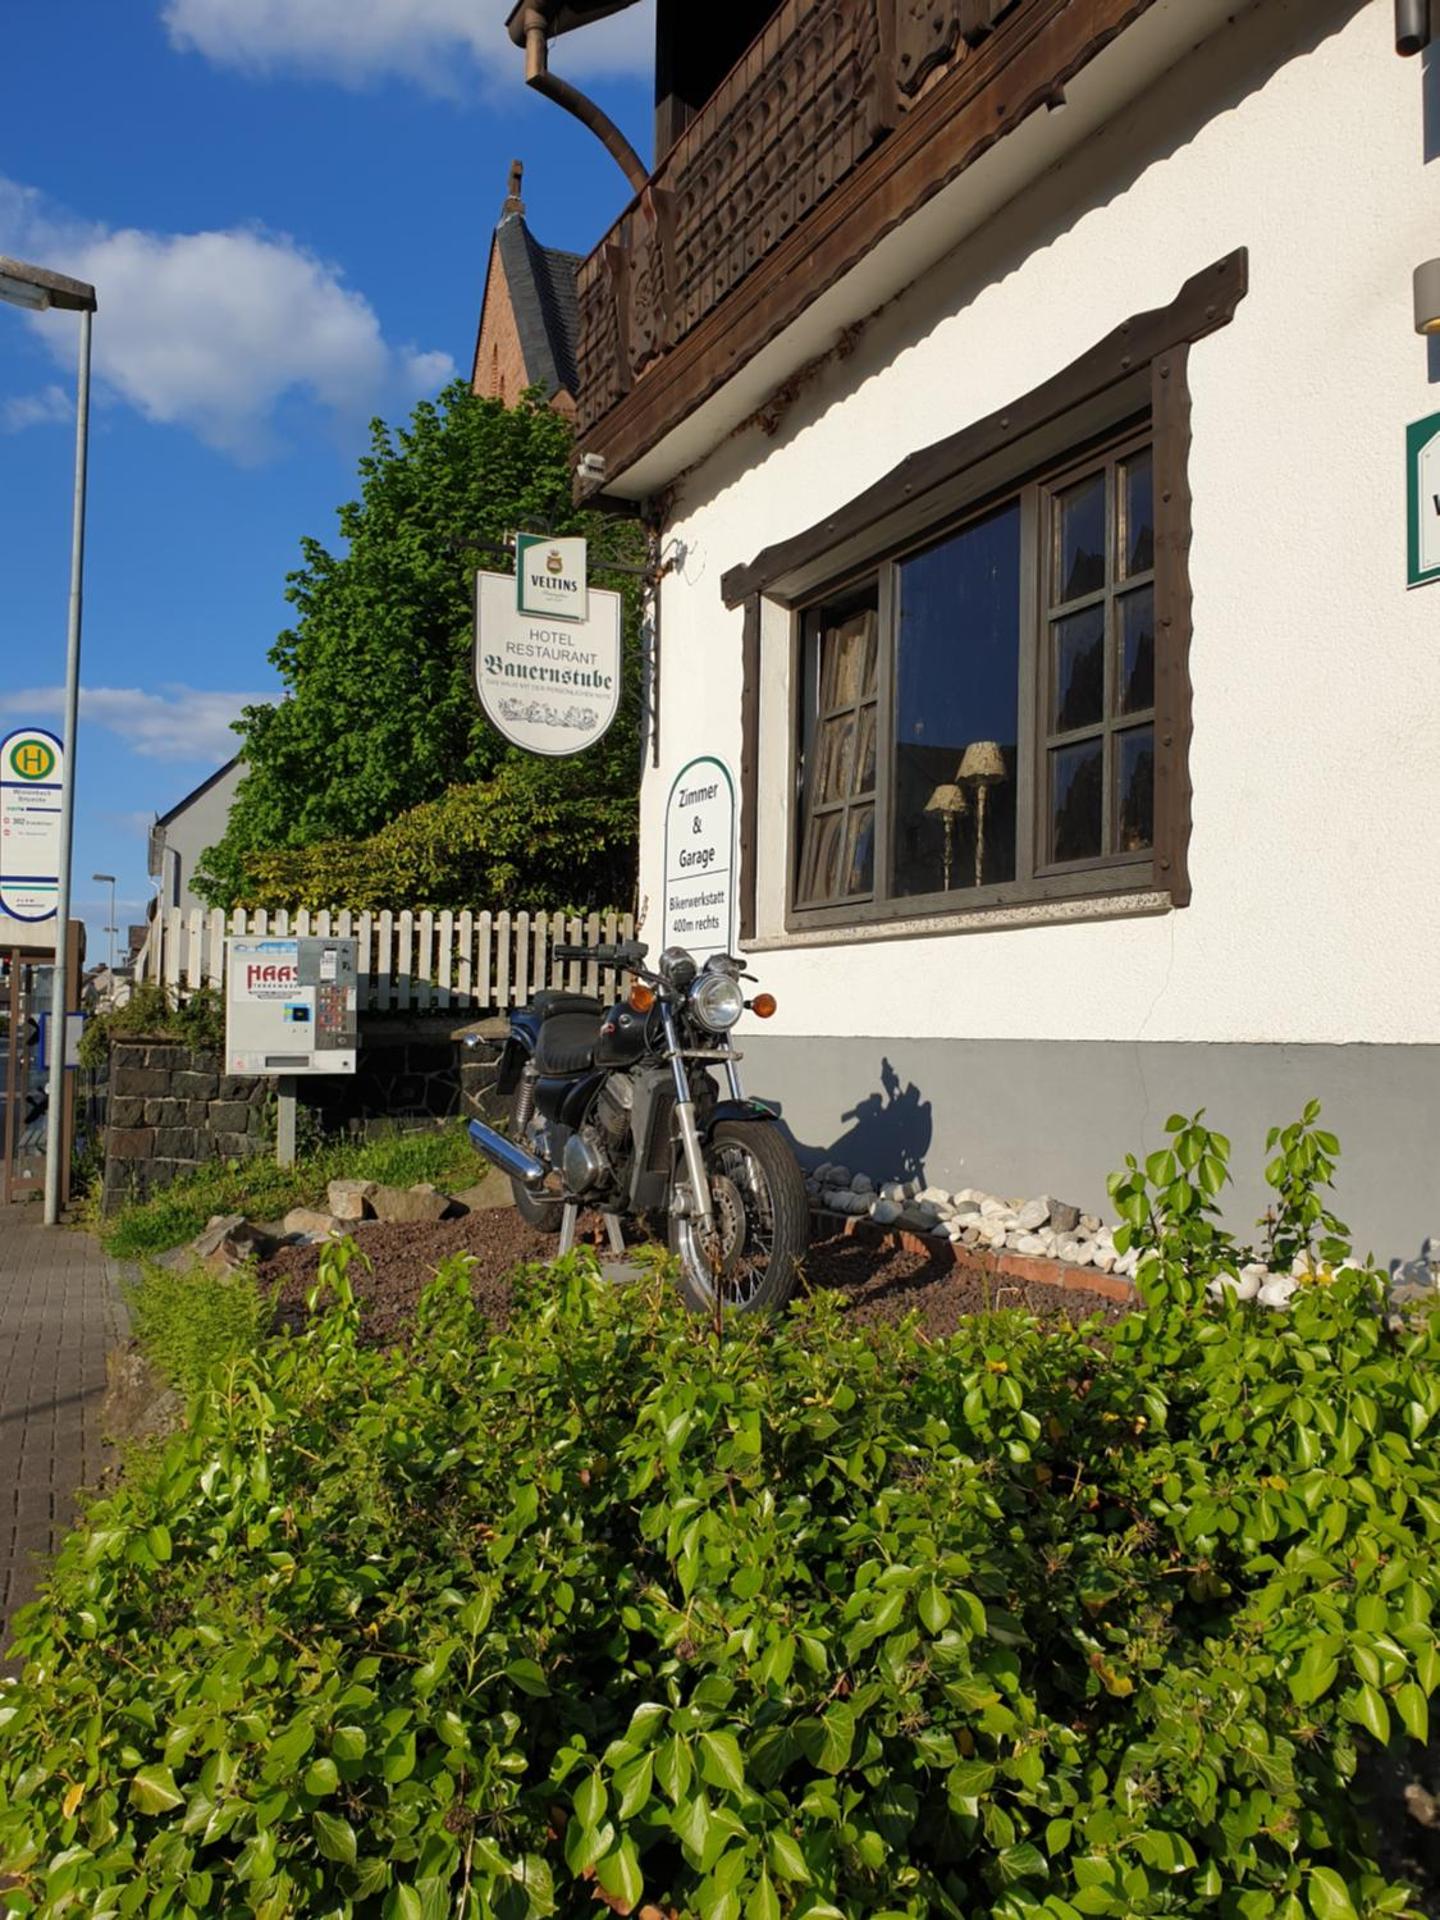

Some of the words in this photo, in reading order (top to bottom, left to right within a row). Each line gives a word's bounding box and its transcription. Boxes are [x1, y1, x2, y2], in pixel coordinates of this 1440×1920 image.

[531, 574, 578, 592] VELTINS
[529, 628, 574, 646] HOTEL
[506, 641, 598, 665] RESTAURANT
[484, 654, 613, 690] Bauernstube
[24, 749, 42, 771] H
[678, 783, 719, 808] Zimmer
[692, 816, 702, 834] &
[679, 847, 716, 869] Garage
[669, 891, 725, 911] Bikerwerkstatt
[673, 918, 694, 932] 400m
[695, 915, 720, 930] rechts
